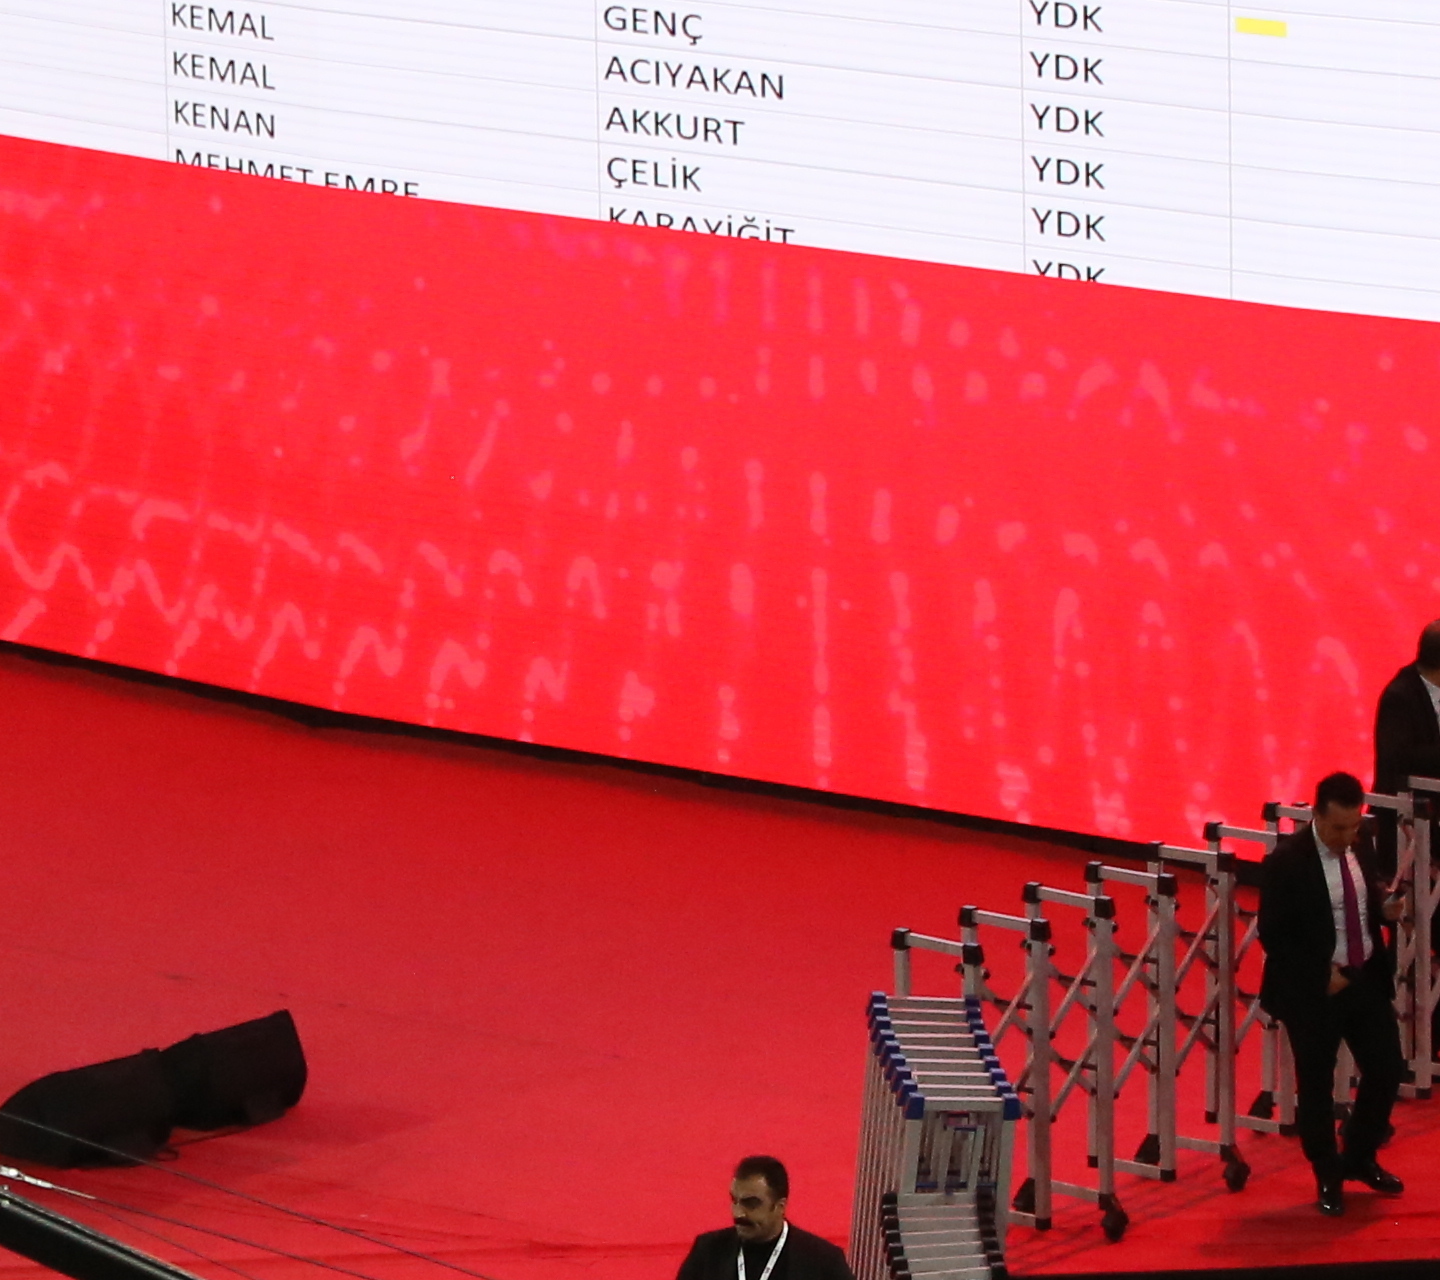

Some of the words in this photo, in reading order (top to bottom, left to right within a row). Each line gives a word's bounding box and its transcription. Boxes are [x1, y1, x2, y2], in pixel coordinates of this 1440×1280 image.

[172, 3, 273, 40] KEMAL
[603, 5, 702, 45] GENÇ
[1029, 0, 1102, 32] YDK
[173, 51, 275, 90] KEMAL
[605, 56, 784, 100] ACIYAKAN
[1030, 51, 1102, 84] YDK
[174, 100, 275, 138] KENAN
[605, 106, 744, 145] AKKURT
[1030, 103, 1103, 137] YDK
[607, 157, 700, 192] ÇELİK
[1031, 156, 1104, 189] YDK
[1032, 207, 1105, 241] YDK
